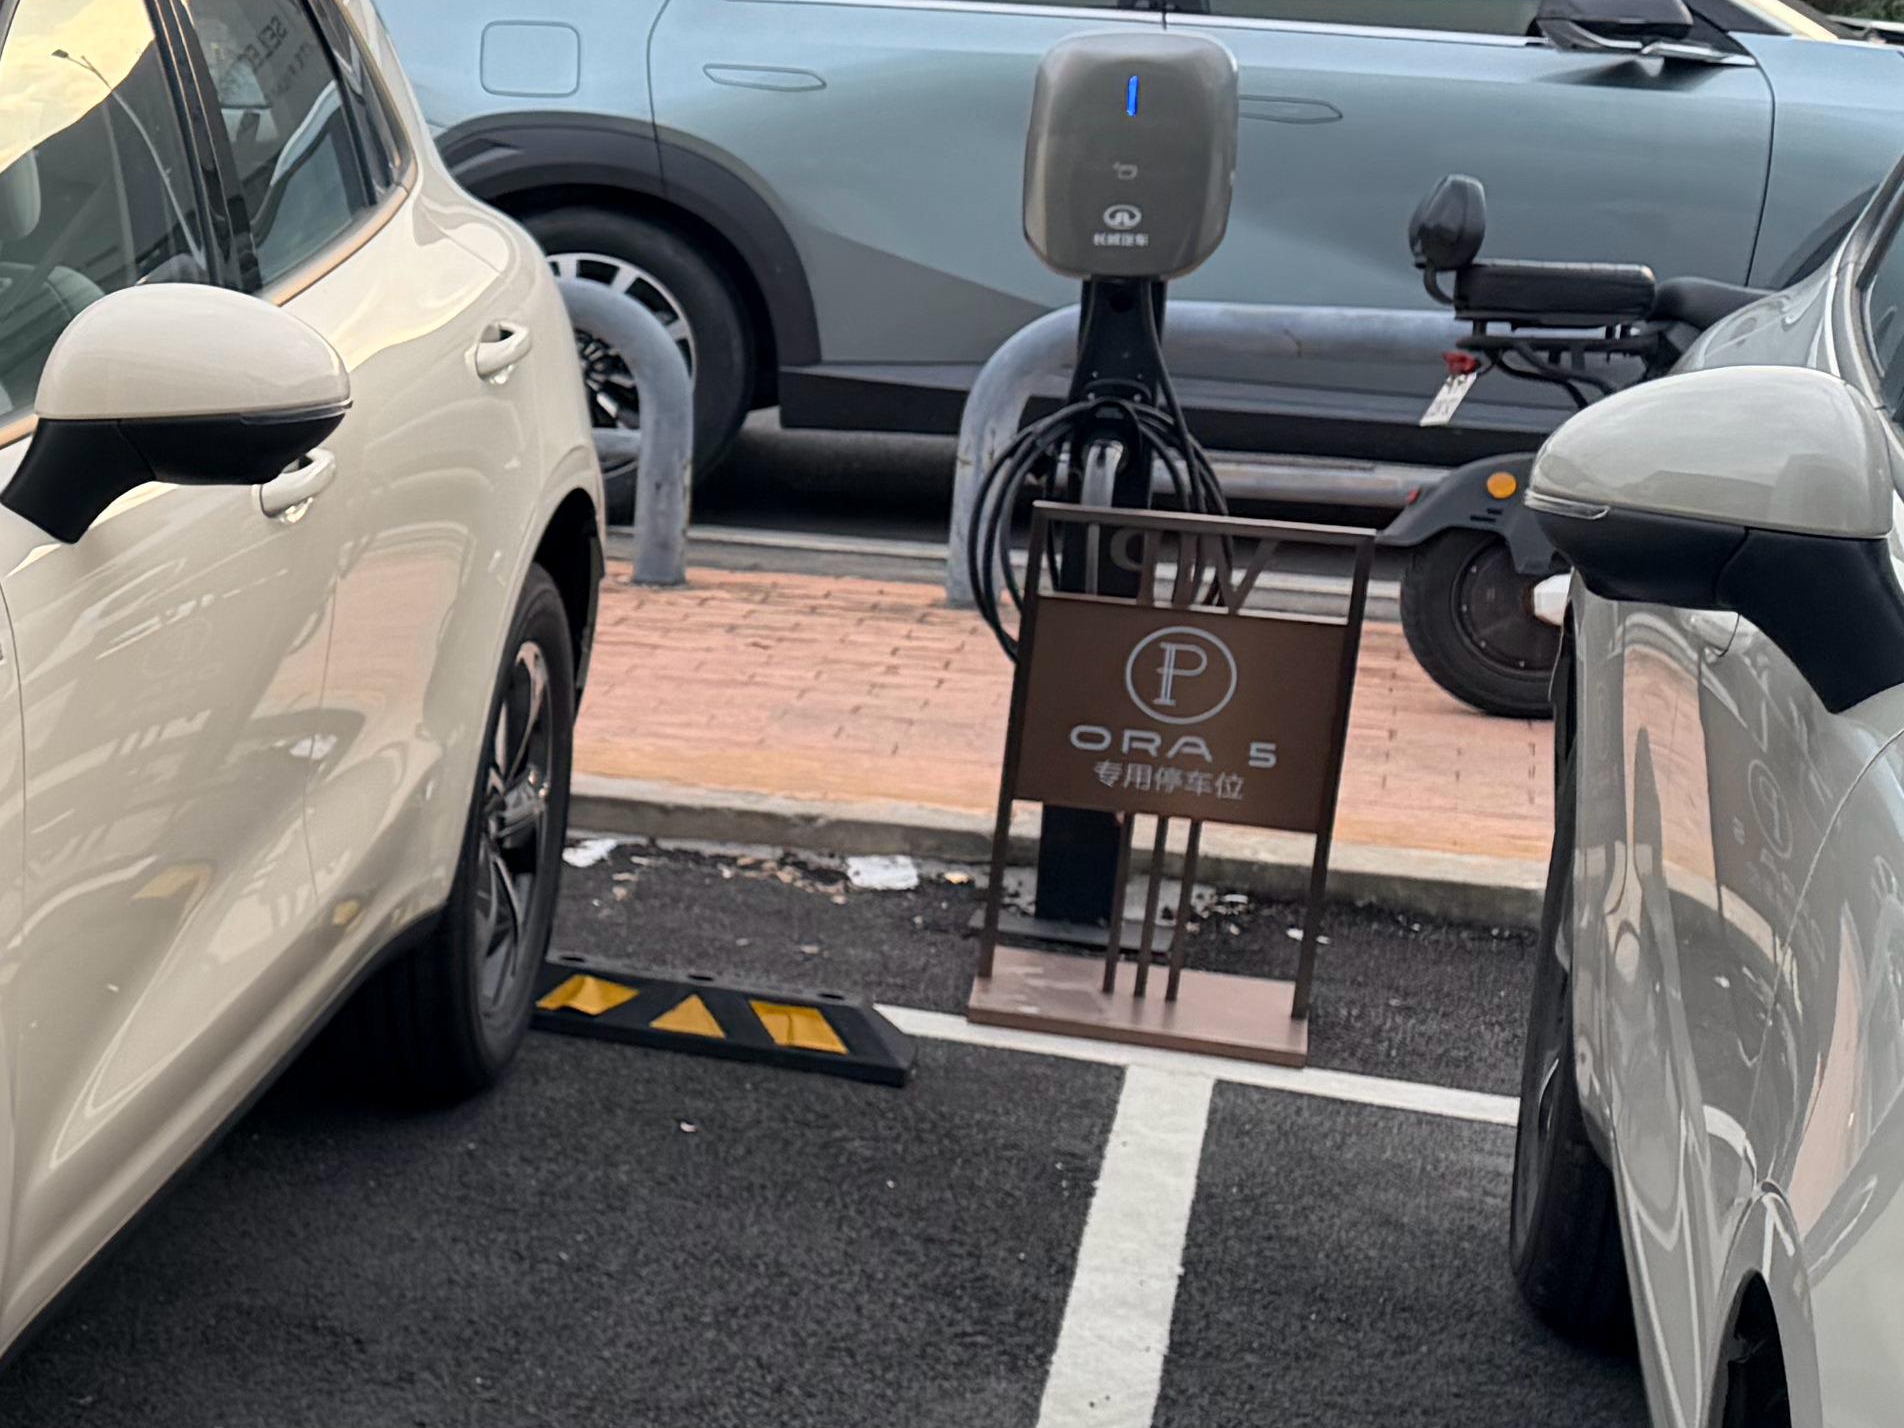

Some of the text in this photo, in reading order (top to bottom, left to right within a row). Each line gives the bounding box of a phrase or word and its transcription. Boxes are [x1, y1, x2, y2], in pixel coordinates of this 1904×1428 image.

[1070, 724, 1277, 768] ORA 5
[1094, 759, 1245, 801] 专用停车位
